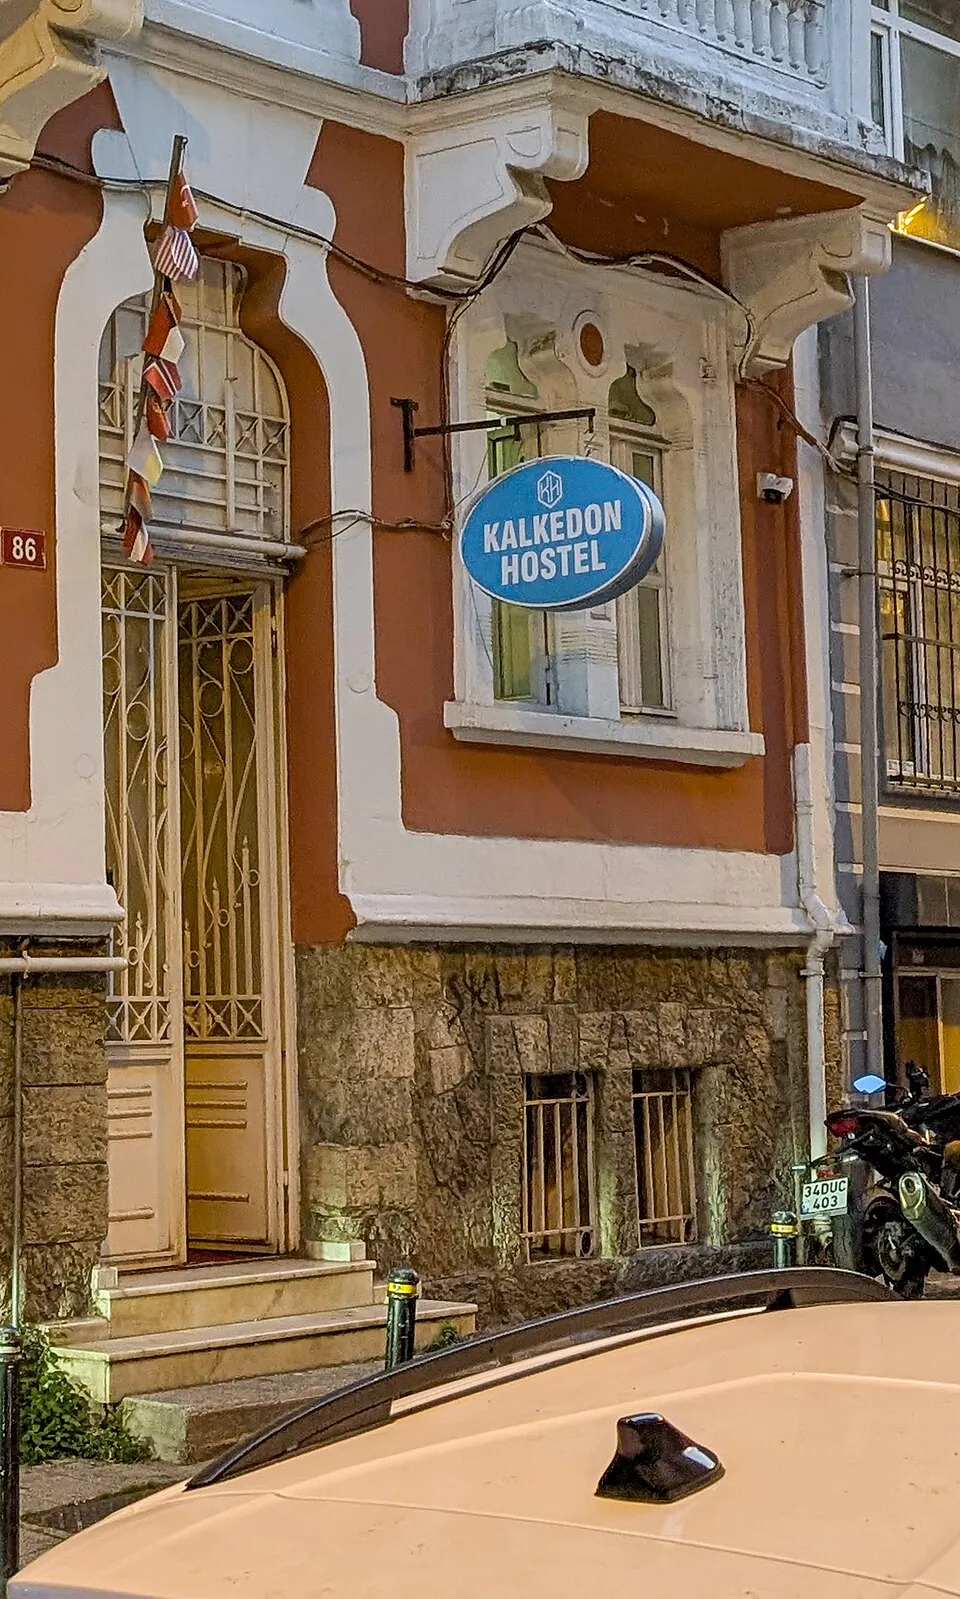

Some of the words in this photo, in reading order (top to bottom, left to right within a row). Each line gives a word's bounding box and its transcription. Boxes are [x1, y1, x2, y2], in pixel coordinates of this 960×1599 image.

[483, 500, 622, 553] KALKEDON
[12, 535, 36, 561] 86
[501, 540, 607, 586] HOSTEL
[804, 1180, 846, 1198] 34DUC
[813, 1195, 838, 1209] 403
